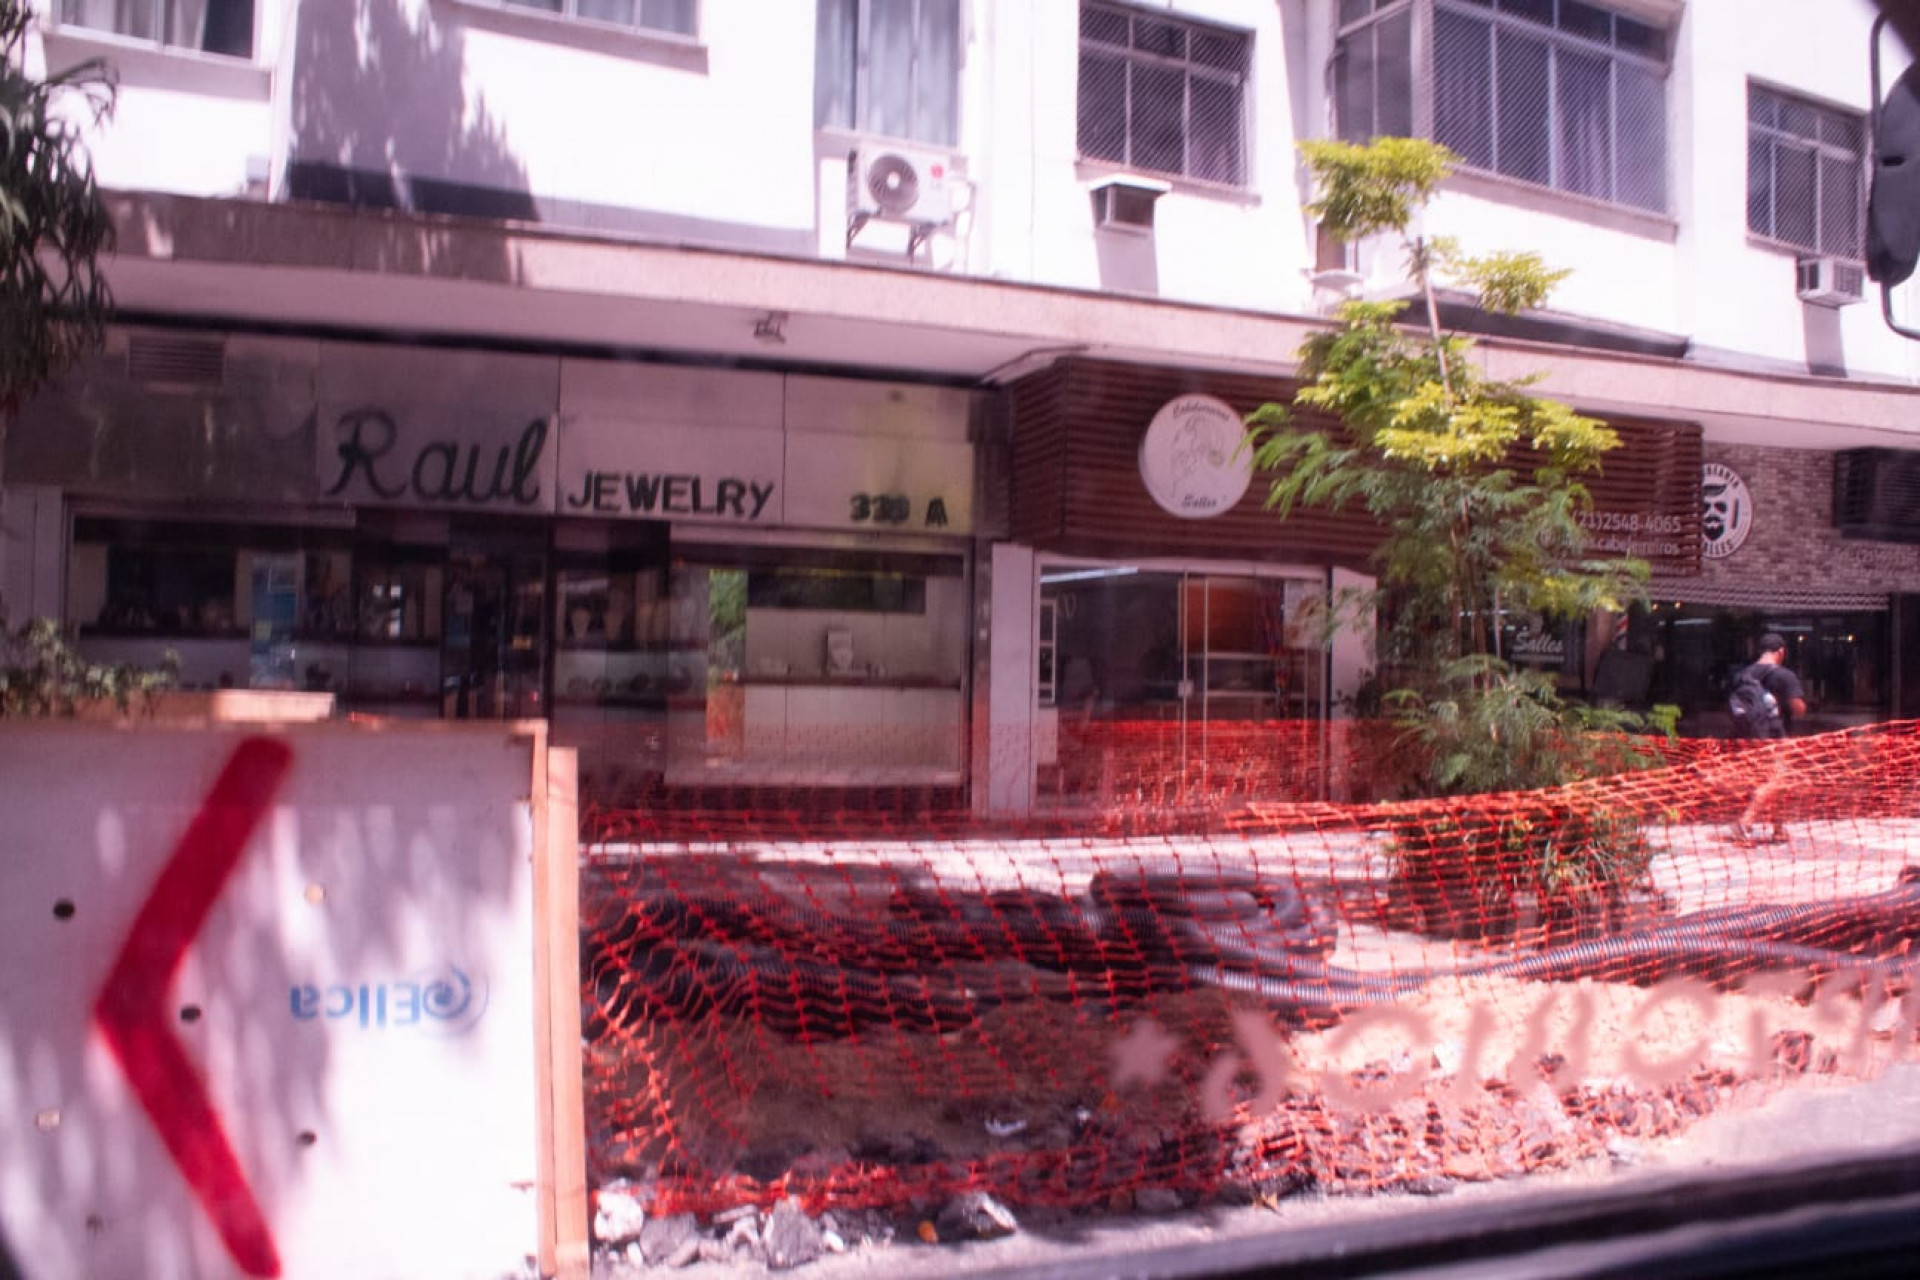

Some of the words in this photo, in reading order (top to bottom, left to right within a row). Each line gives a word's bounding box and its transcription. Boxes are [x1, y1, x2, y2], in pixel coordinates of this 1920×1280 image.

[325, 409, 548, 504] Raul
[568, 470, 774, 519] JEWELRY
[925, 497, 949, 527] A
